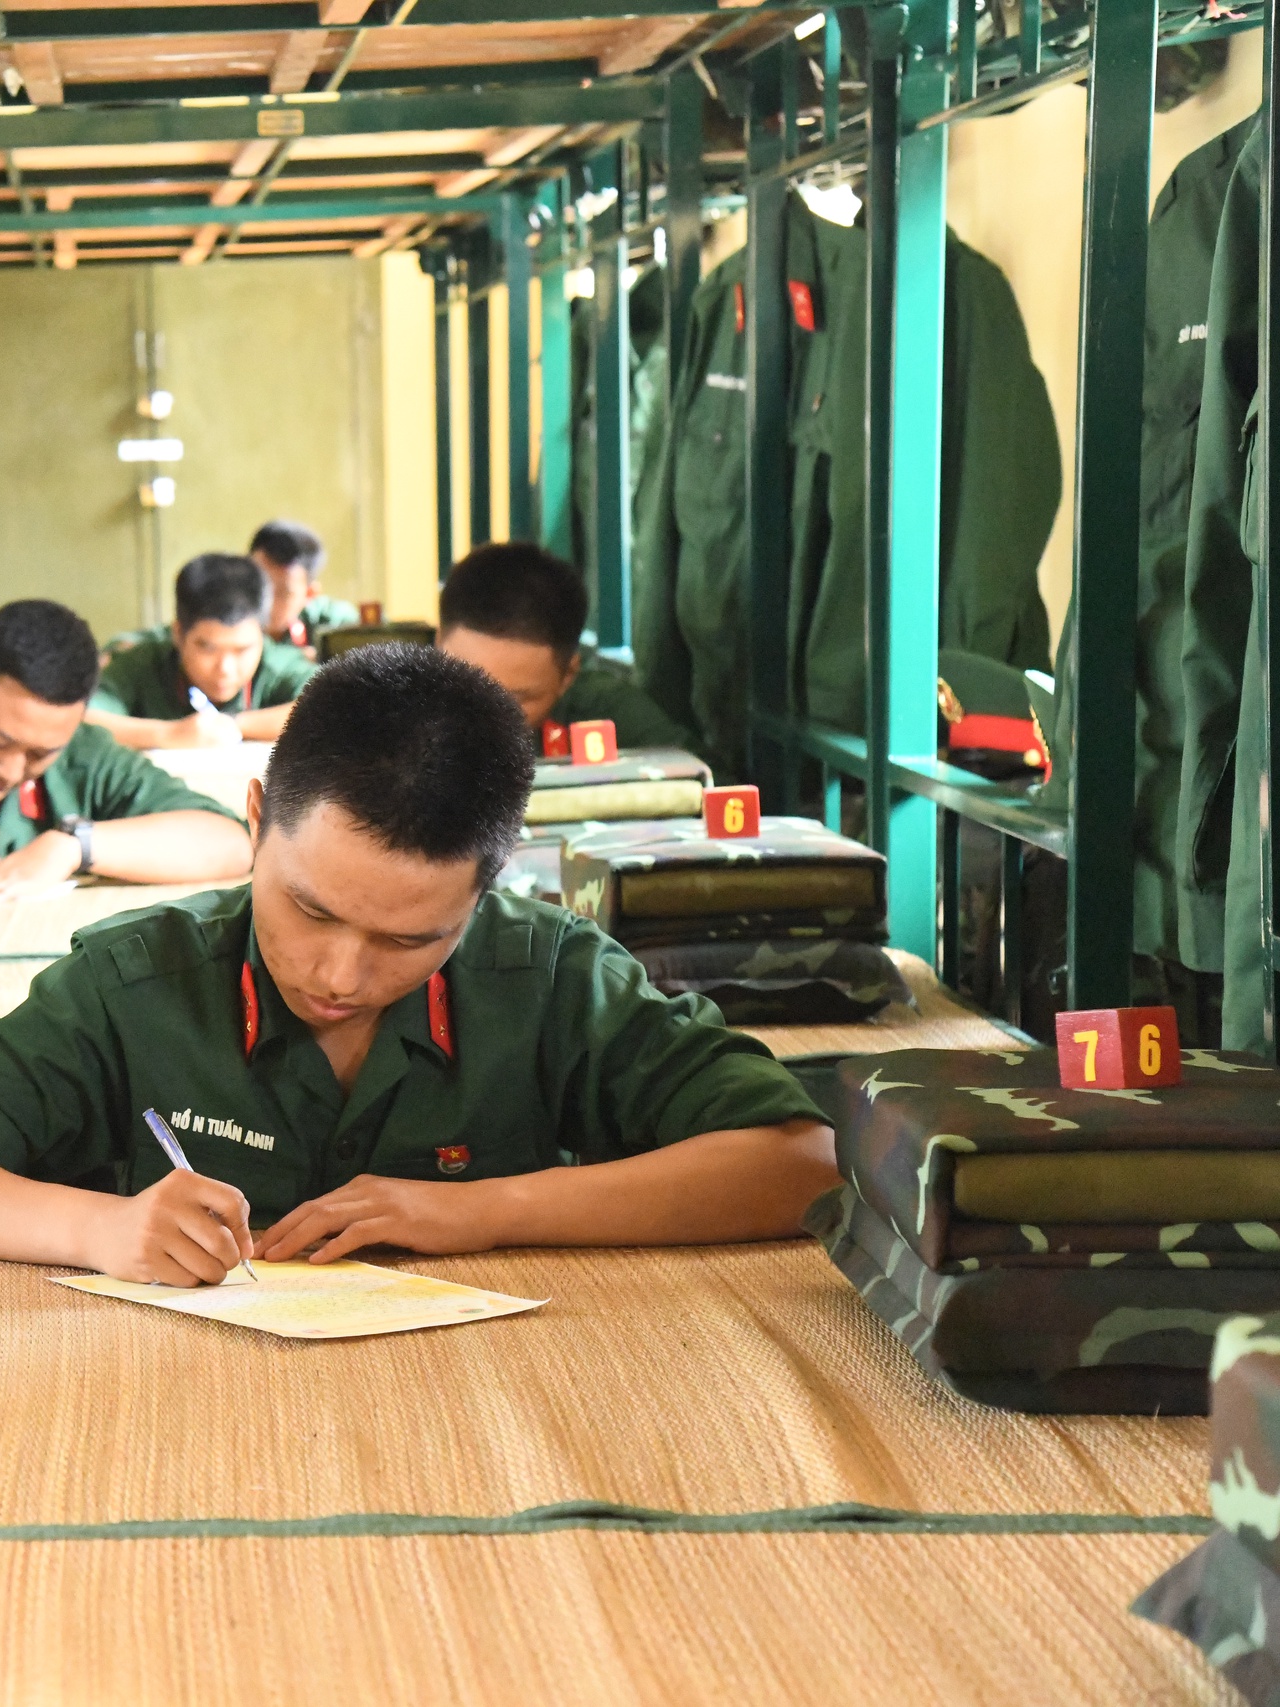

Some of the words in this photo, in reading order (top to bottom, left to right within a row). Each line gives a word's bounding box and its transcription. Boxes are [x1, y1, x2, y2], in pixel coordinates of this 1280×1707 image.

[585, 731, 605, 762] 6
[723, 798, 744, 833] 6
[1074, 1030, 1098, 1082] 7
[1139, 1024, 1161, 1076] 6
[192, 1115, 205, 1133] N
[207, 1118, 243, 1143] TUẤN
[244, 1130, 275, 1151] ANH
